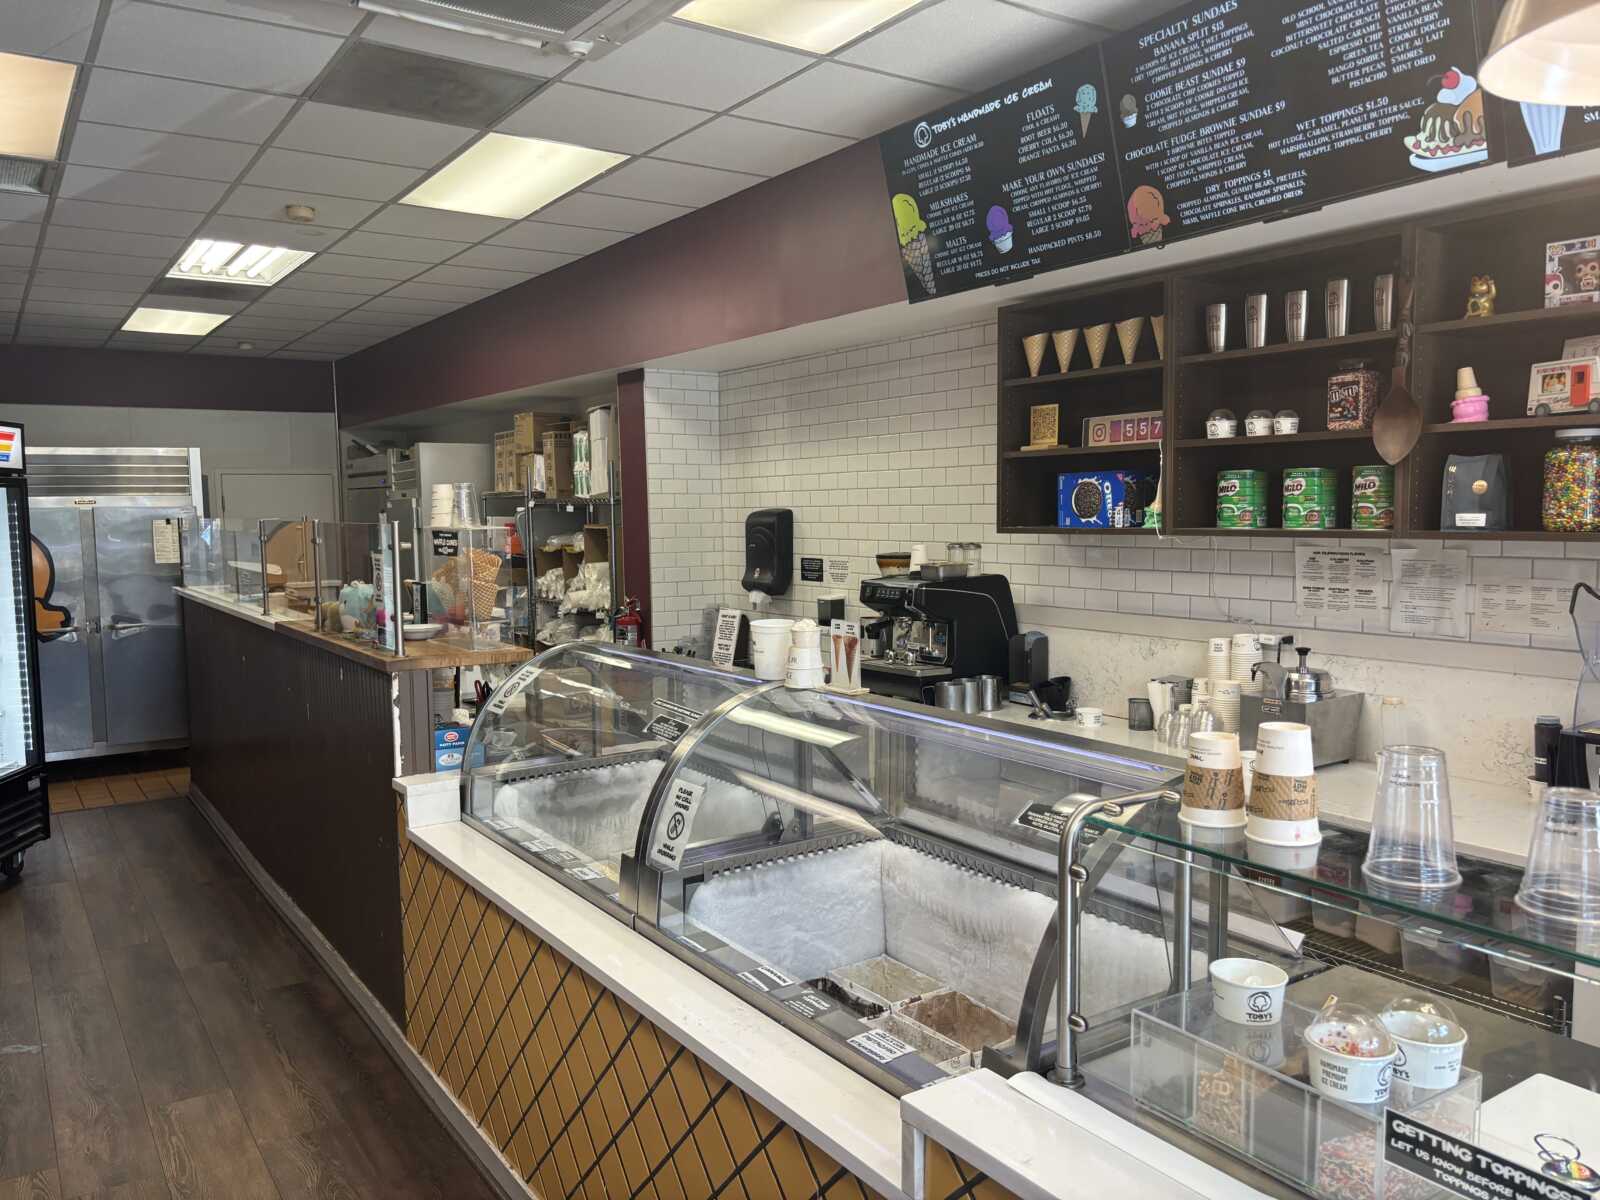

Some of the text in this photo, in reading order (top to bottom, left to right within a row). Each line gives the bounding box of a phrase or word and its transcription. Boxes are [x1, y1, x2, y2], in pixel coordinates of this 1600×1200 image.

[1139, 0, 1237, 48] SPECIALTY SUNDAES
[1153, 20, 1224, 56] BANANA SPLIT $13
[1144, 57, 1245, 102] COOKIE BEAST SUNDAE $9
[931, 78, 1052, 133] TOBY'S HANDMADE ICE CREAM
[1026, 104, 1054, 122] FLOATS
[1296, 96, 1388, 131] WET TOPPINGS $1.50
[1125, 100, 1285, 160] CHOCOLATE FUDGE BROWNIE SUNDAE $9
[904, 133, 976, 167] HANDMADE ICE CREAM
[1002, 152, 1105, 192] MAKE YOUR OWN SUNDAES!
[1205, 169, 1271, 194] DRY TOPPINGS $1
[929, 192, 968, 210] MILKSHAKES
[1104, 481, 1113, 518] OREO
[1355, 481, 1376, 491] MILO
[1246, 1012, 1273, 1020] TOBY'S
[1320, 1059, 1349, 1075] HANDMADE
[1322, 1069, 1347, 1083] PREMIUM
[1330, 1080, 1348, 1093] CREAM
[1391, 1119, 1473, 1163] GETTING
[1391, 1139, 1413, 1153] LET
[1415, 1148, 1430, 1161] US
[1432, 1155, 1464, 1176] KNOW
[1466, 1171, 1514, 1199] BEFORE
[1433, 1168, 1489, 1200] TOPPINGS
